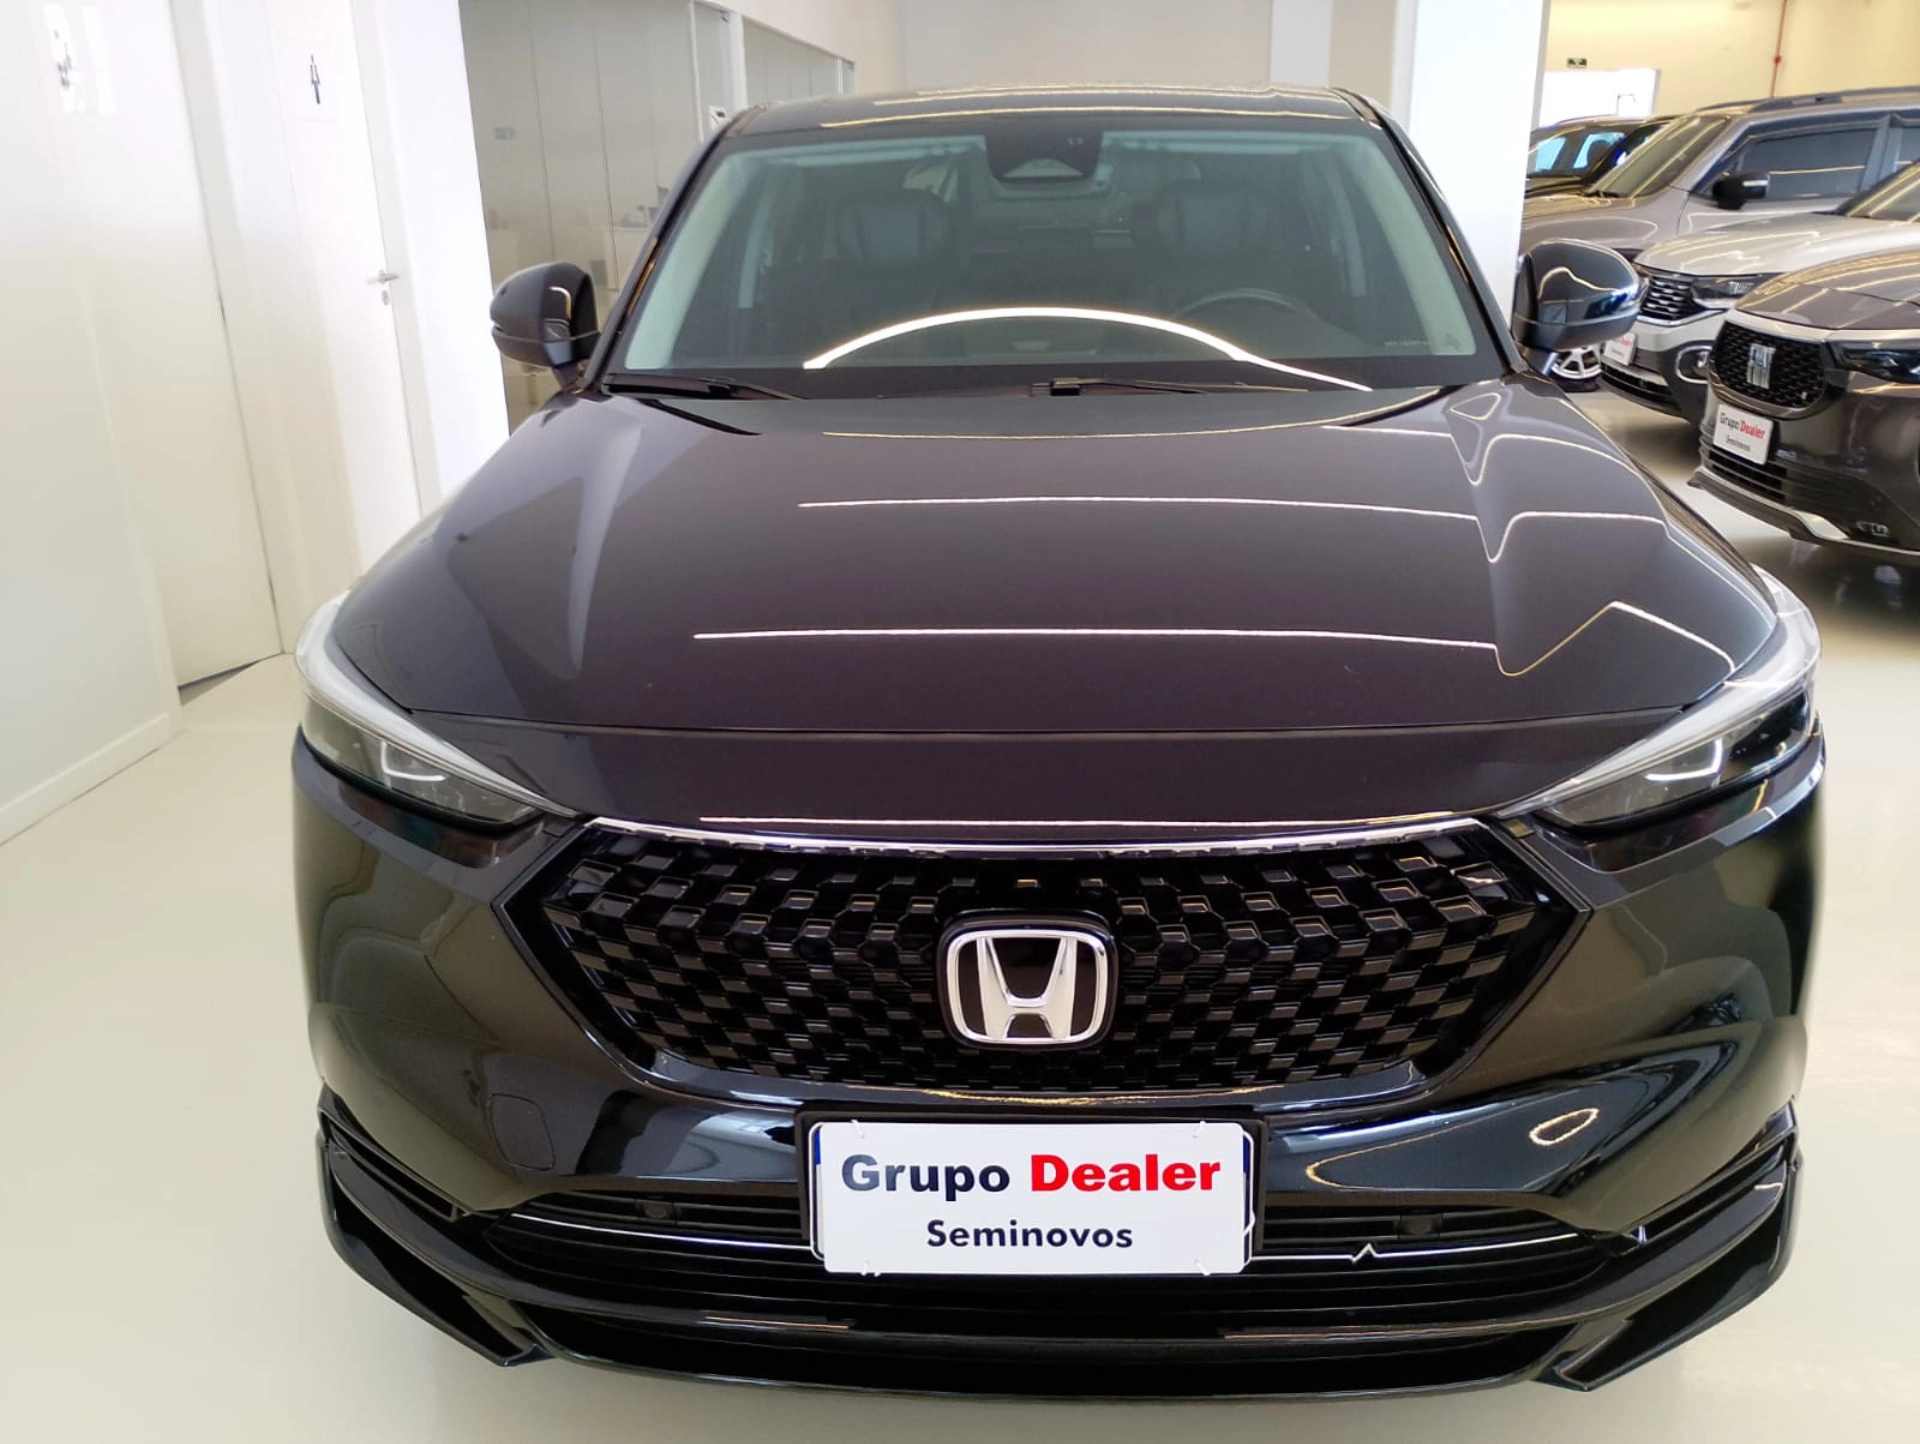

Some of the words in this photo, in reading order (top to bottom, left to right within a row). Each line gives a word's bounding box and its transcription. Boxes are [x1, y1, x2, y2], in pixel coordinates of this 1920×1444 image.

[841, 1153, 1010, 1201] Grupo
[1030, 1153, 1221, 1192] Dealer
[926, 1218, 1133, 1249] Seminovos
